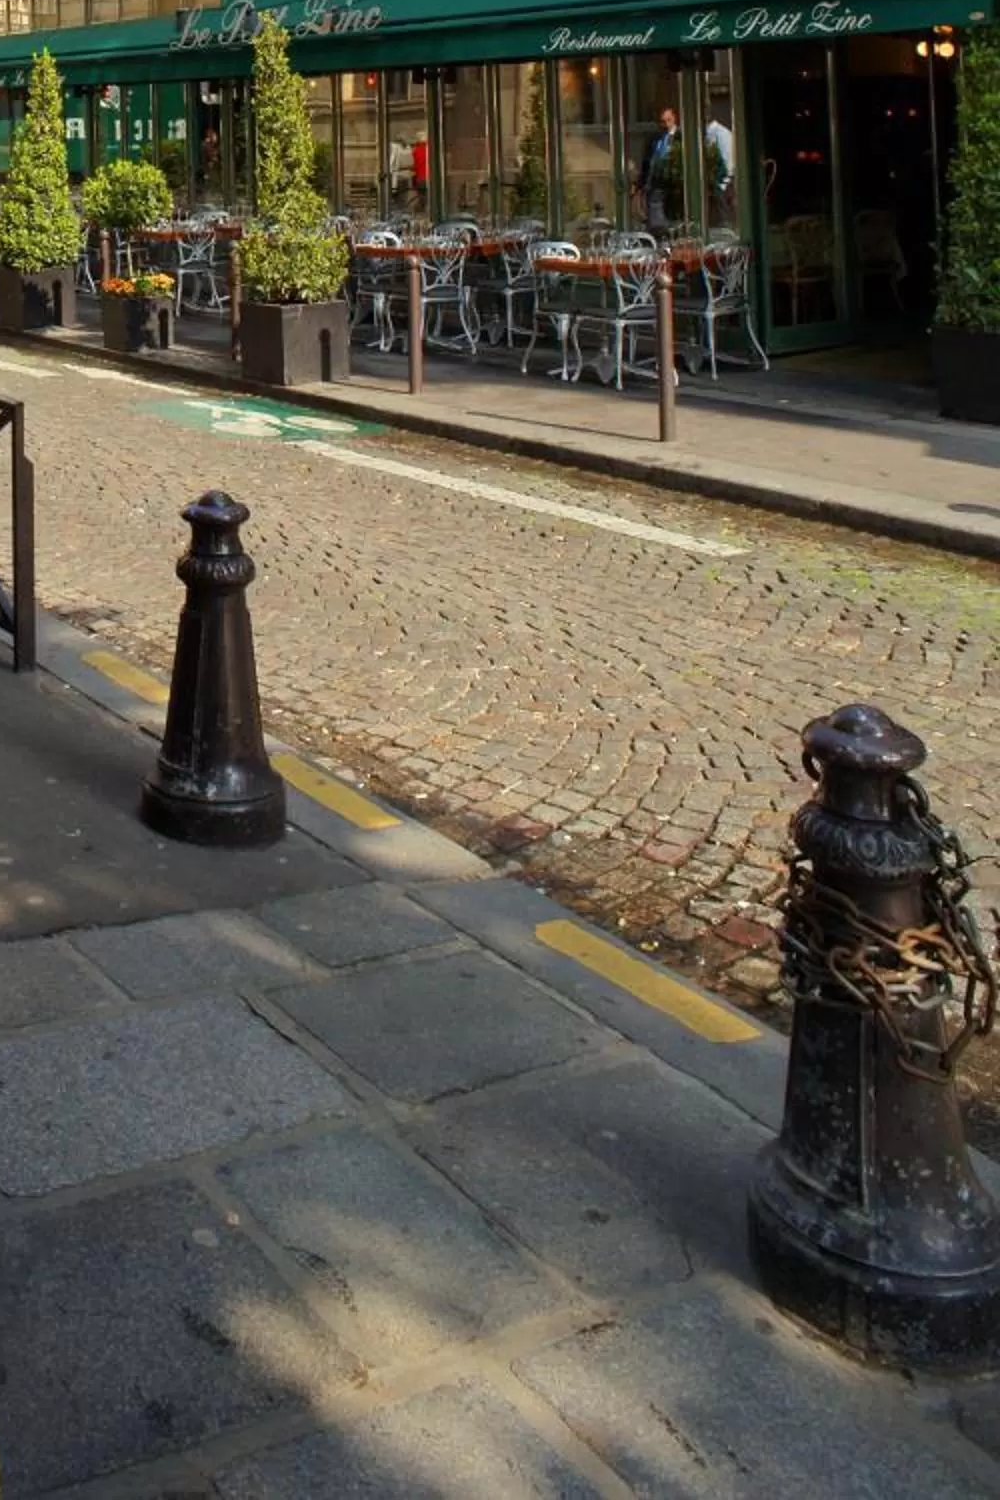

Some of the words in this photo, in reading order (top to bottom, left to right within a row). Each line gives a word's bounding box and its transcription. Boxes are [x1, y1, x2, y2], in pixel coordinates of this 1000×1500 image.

[169, 4, 211, 49] Le
[541, 26, 657, 53] Restaurant
[680, 10, 722, 43] Le
[733, 7, 802, 40] Petit
[805, 0, 873, 33] Zinc
